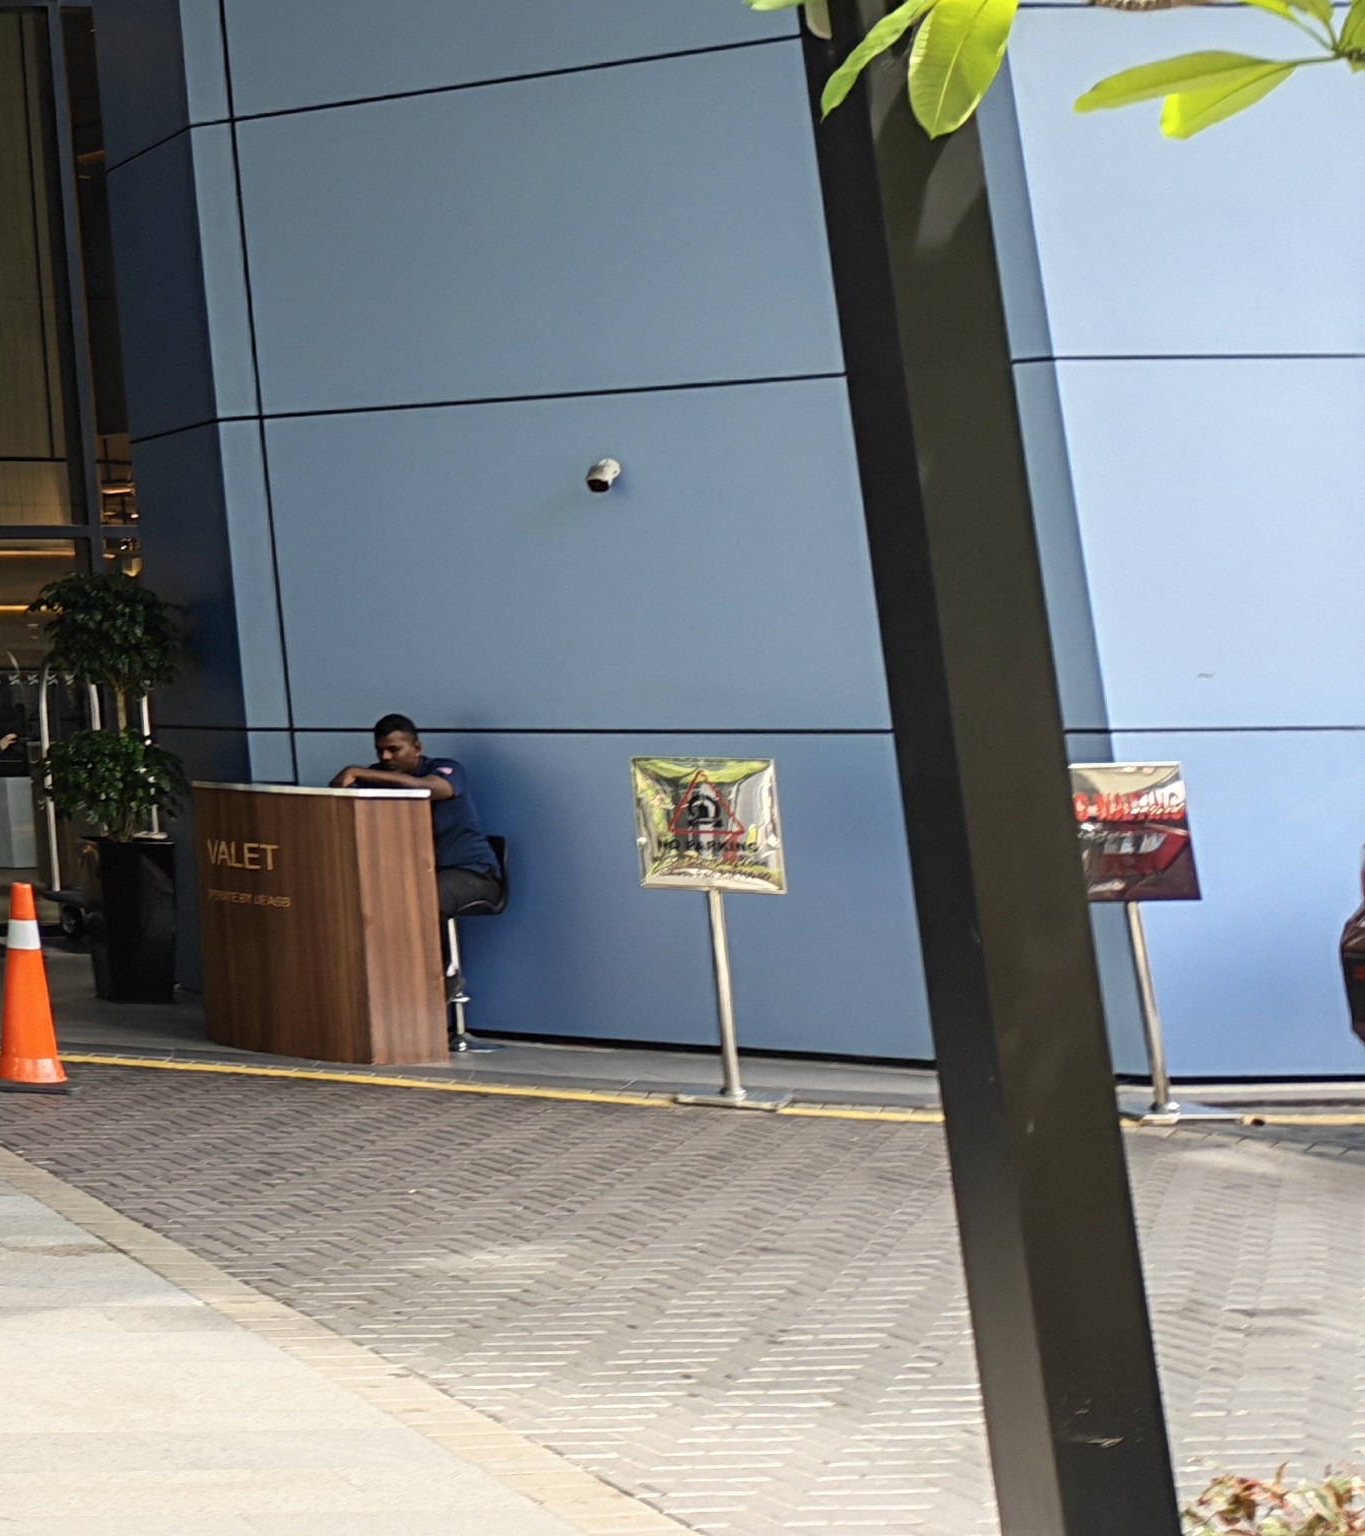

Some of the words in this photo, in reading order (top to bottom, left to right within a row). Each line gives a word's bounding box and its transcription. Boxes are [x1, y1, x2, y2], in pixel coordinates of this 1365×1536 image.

[207, 838, 280, 871] VALET
[658, 839, 680, 850] NO
[686, 839, 759, 852] PARKING
